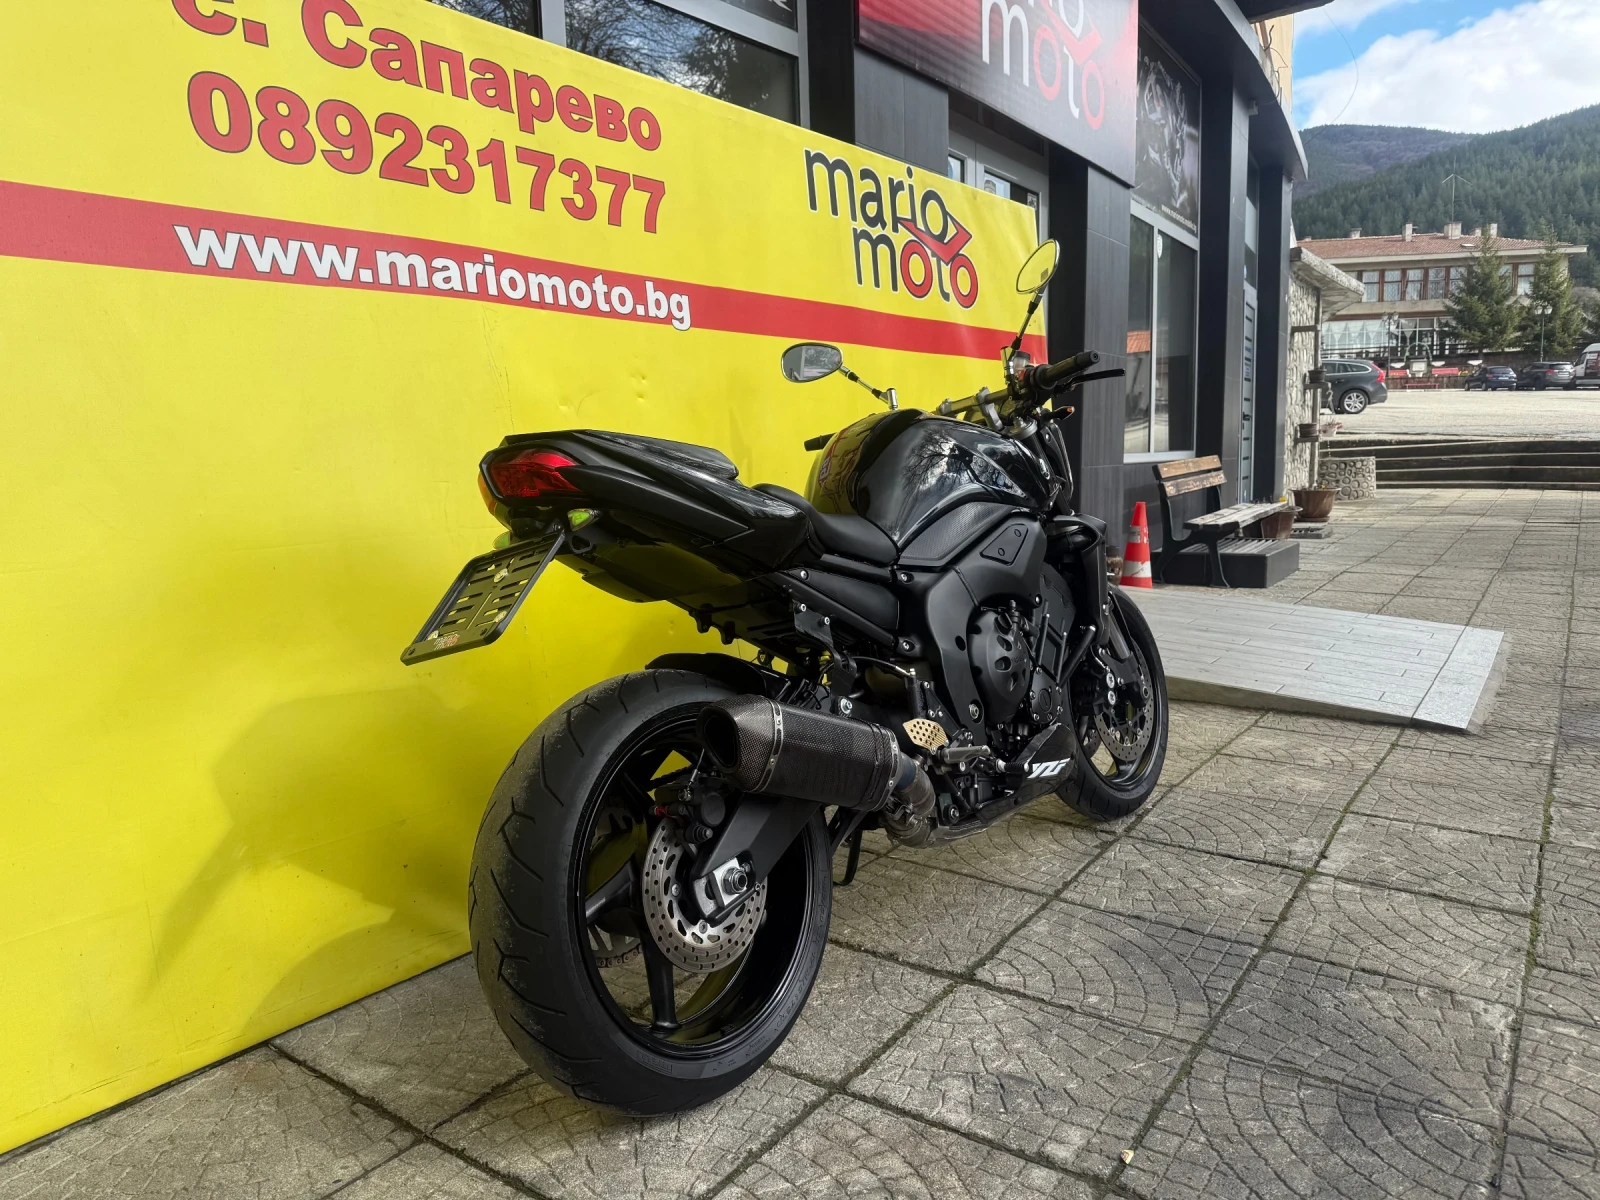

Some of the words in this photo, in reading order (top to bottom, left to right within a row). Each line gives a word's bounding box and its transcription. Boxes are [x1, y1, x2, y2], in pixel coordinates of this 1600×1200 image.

[301, 0, 662, 151] Сапарево
[982, 0, 1105, 130] moto
[187, 71, 666, 234] 0892317377
[804, 149, 950, 244] mario
[172, 223, 692, 331] www.mariomoto.bg
[853, 227, 978, 309] moto
